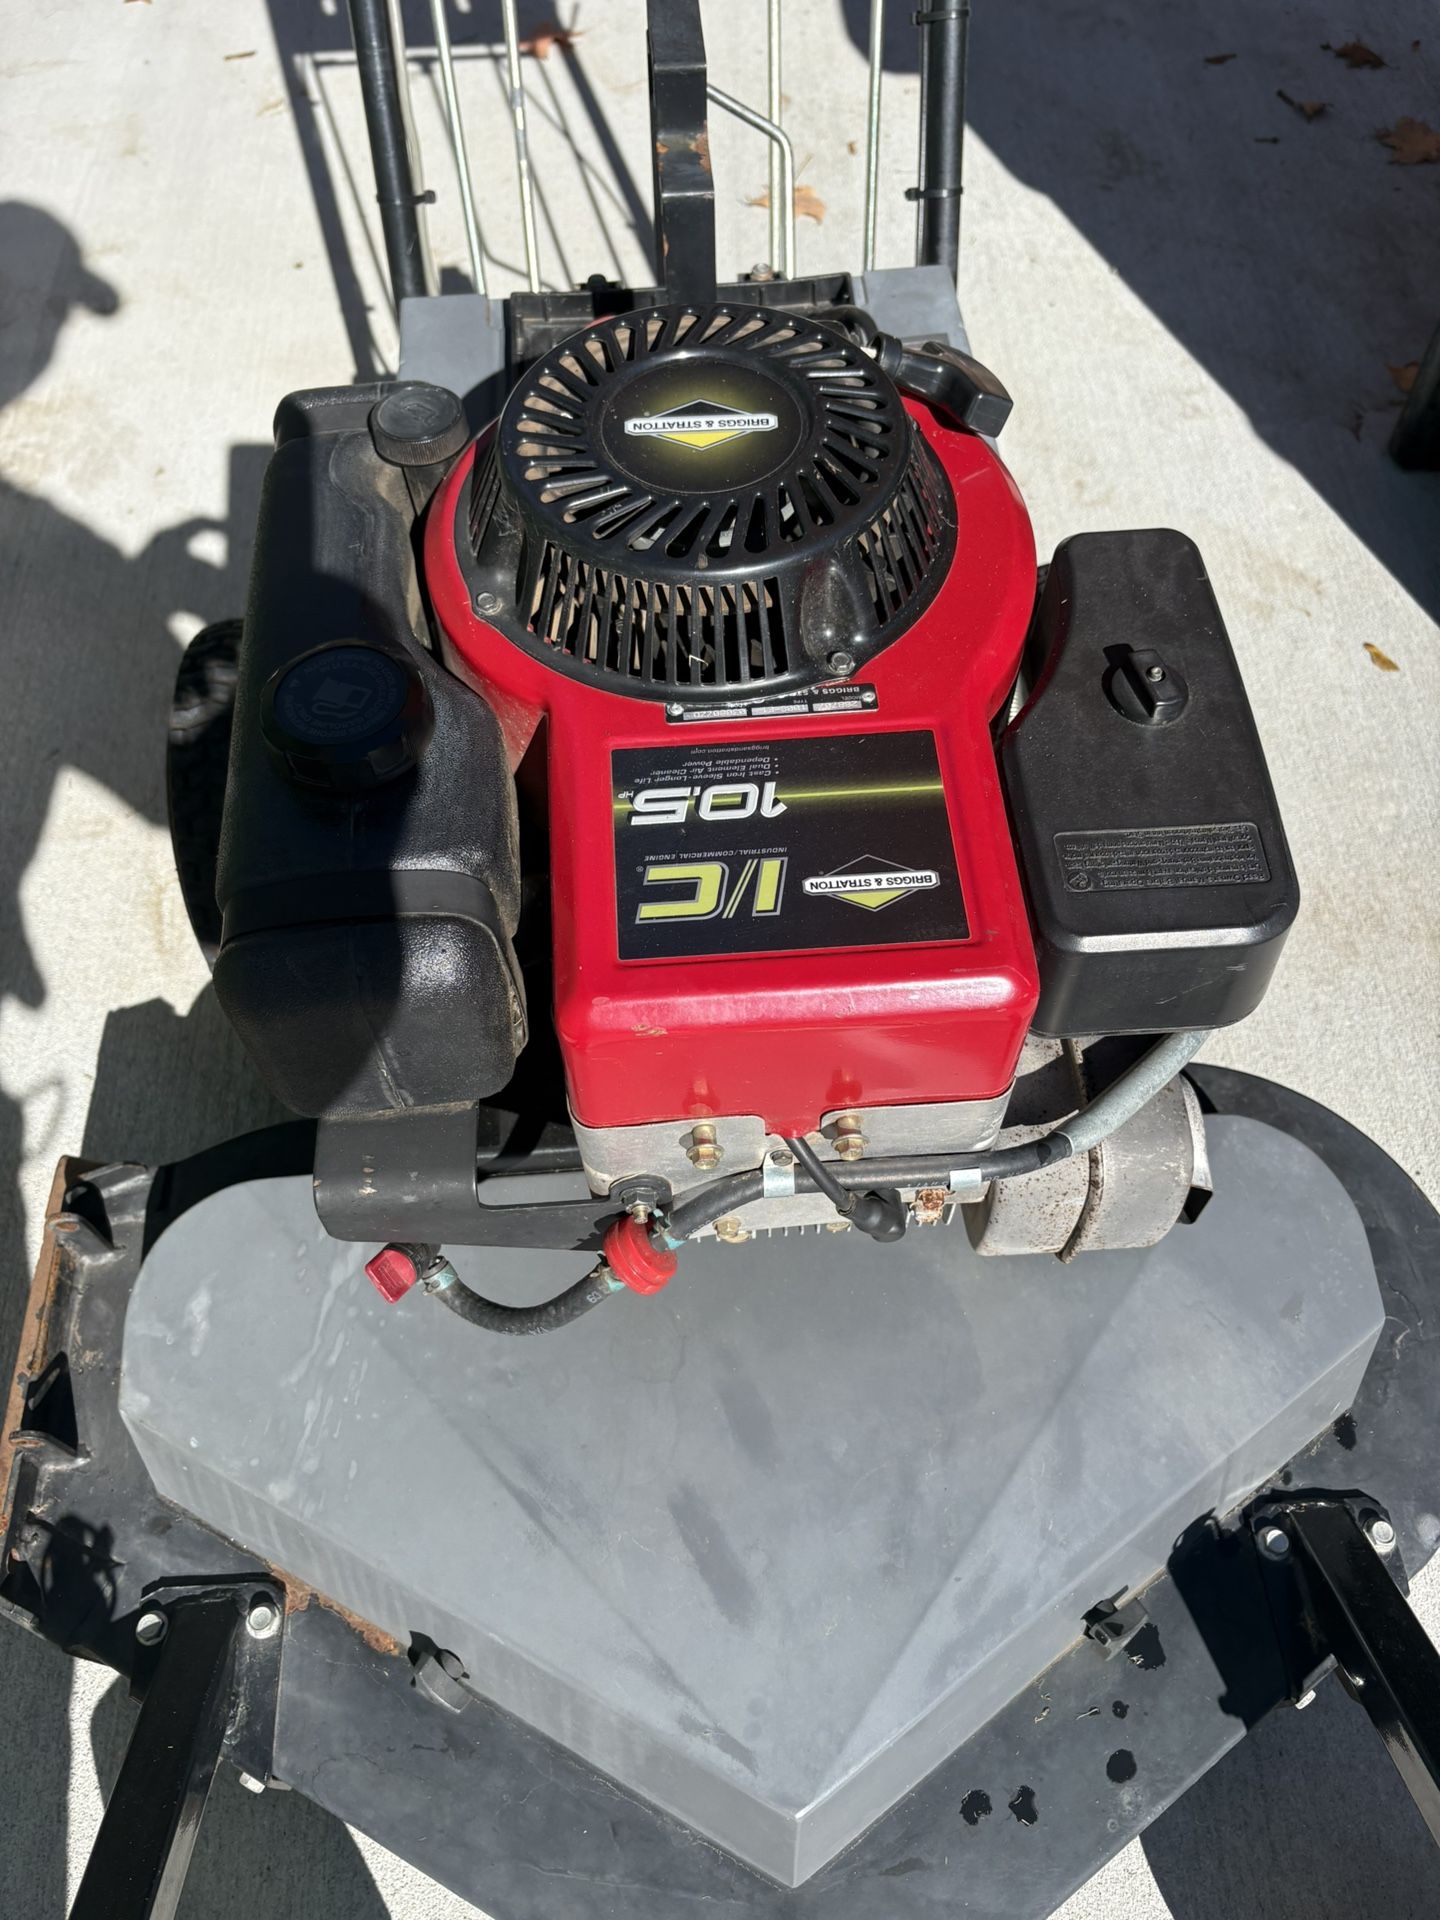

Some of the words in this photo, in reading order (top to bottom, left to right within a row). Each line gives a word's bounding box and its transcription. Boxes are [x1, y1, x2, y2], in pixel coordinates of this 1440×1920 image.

[633, 420, 701, 431] STRATTON
[705, 420, 715, 428] &
[718, 418, 770, 428] BRIGGS
[822, 686, 859, 695] BRIGGS
[690, 745, 770, 755] briggsandstratton.com
[716, 756, 771, 767] Dependable
[707, 765, 747, 773] Element
[617, 790, 634, 799] HP
[630, 781, 788, 826] 10.5
[644, 853, 676, 862] ENGINE
[679, 847, 788, 859] INDUSTRIAL/COMMERCIAL
[810, 878, 872, 890] STRATTON
[873, 877, 883, 886] &
[886, 874, 933, 886] BRIGGS
